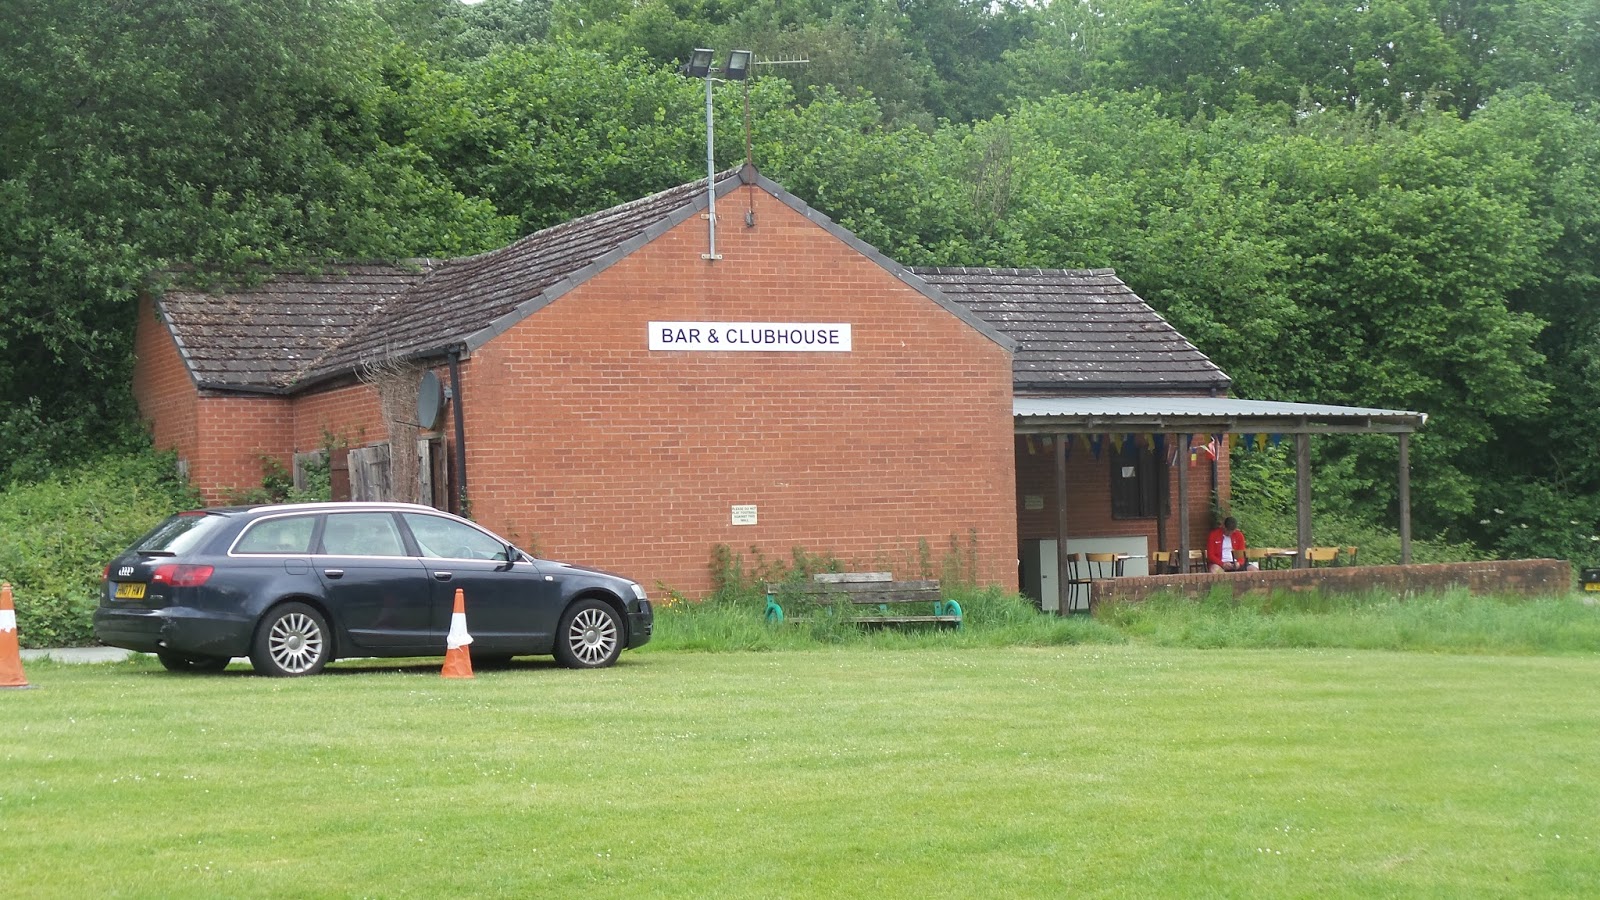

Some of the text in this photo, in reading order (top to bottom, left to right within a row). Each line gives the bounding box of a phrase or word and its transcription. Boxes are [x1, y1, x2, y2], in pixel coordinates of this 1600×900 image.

[662, 328, 840, 344] BAR & CLUBHOUSE
